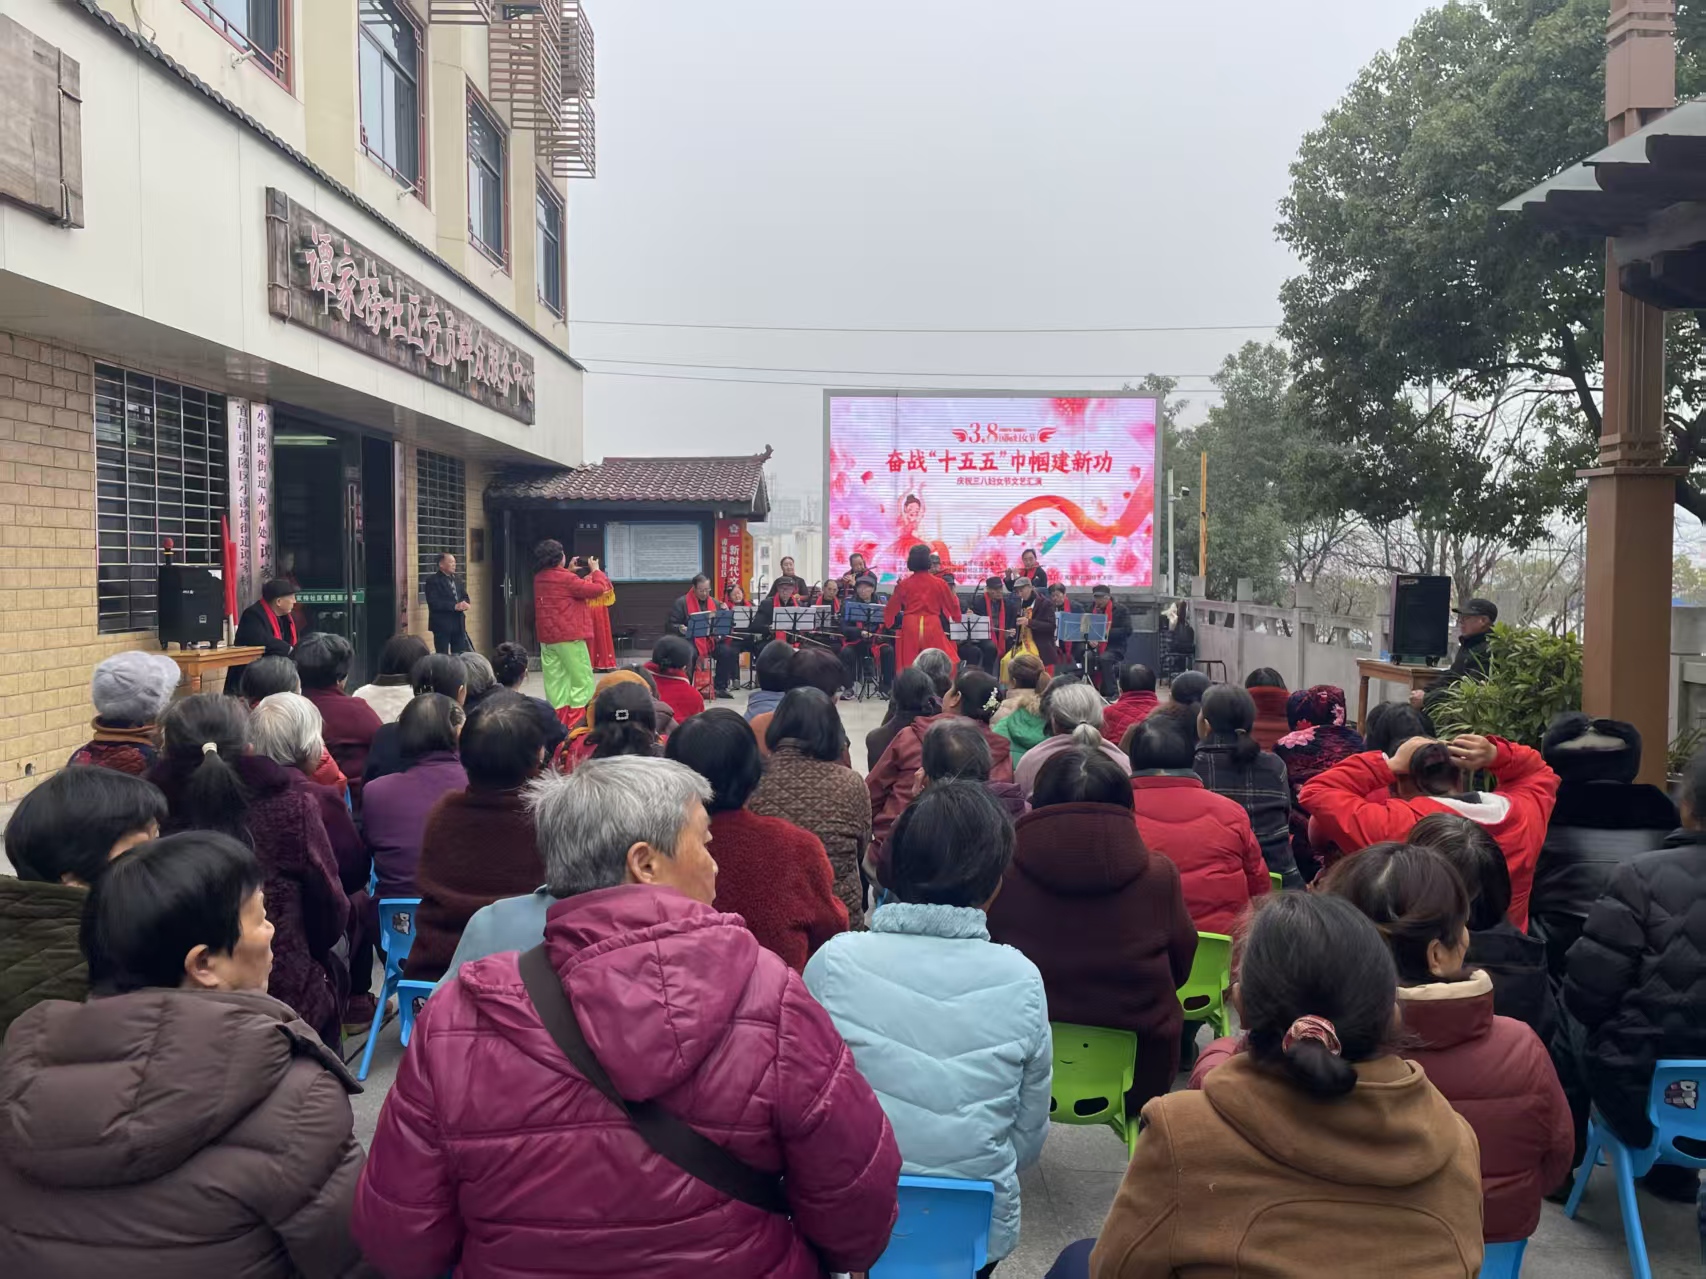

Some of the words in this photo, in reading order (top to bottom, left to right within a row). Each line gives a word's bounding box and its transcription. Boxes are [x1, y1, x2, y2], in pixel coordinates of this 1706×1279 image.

[305, 225, 534, 406] 谭家榜社区党员群众服务中心
[969, 422, 998, 443] 3.8
[885, 449, 1113, 474] 奋战“十五五”巾帼建新功
[956, 476, 1043, 486] 庆祝三八妇女节文艺汇演
